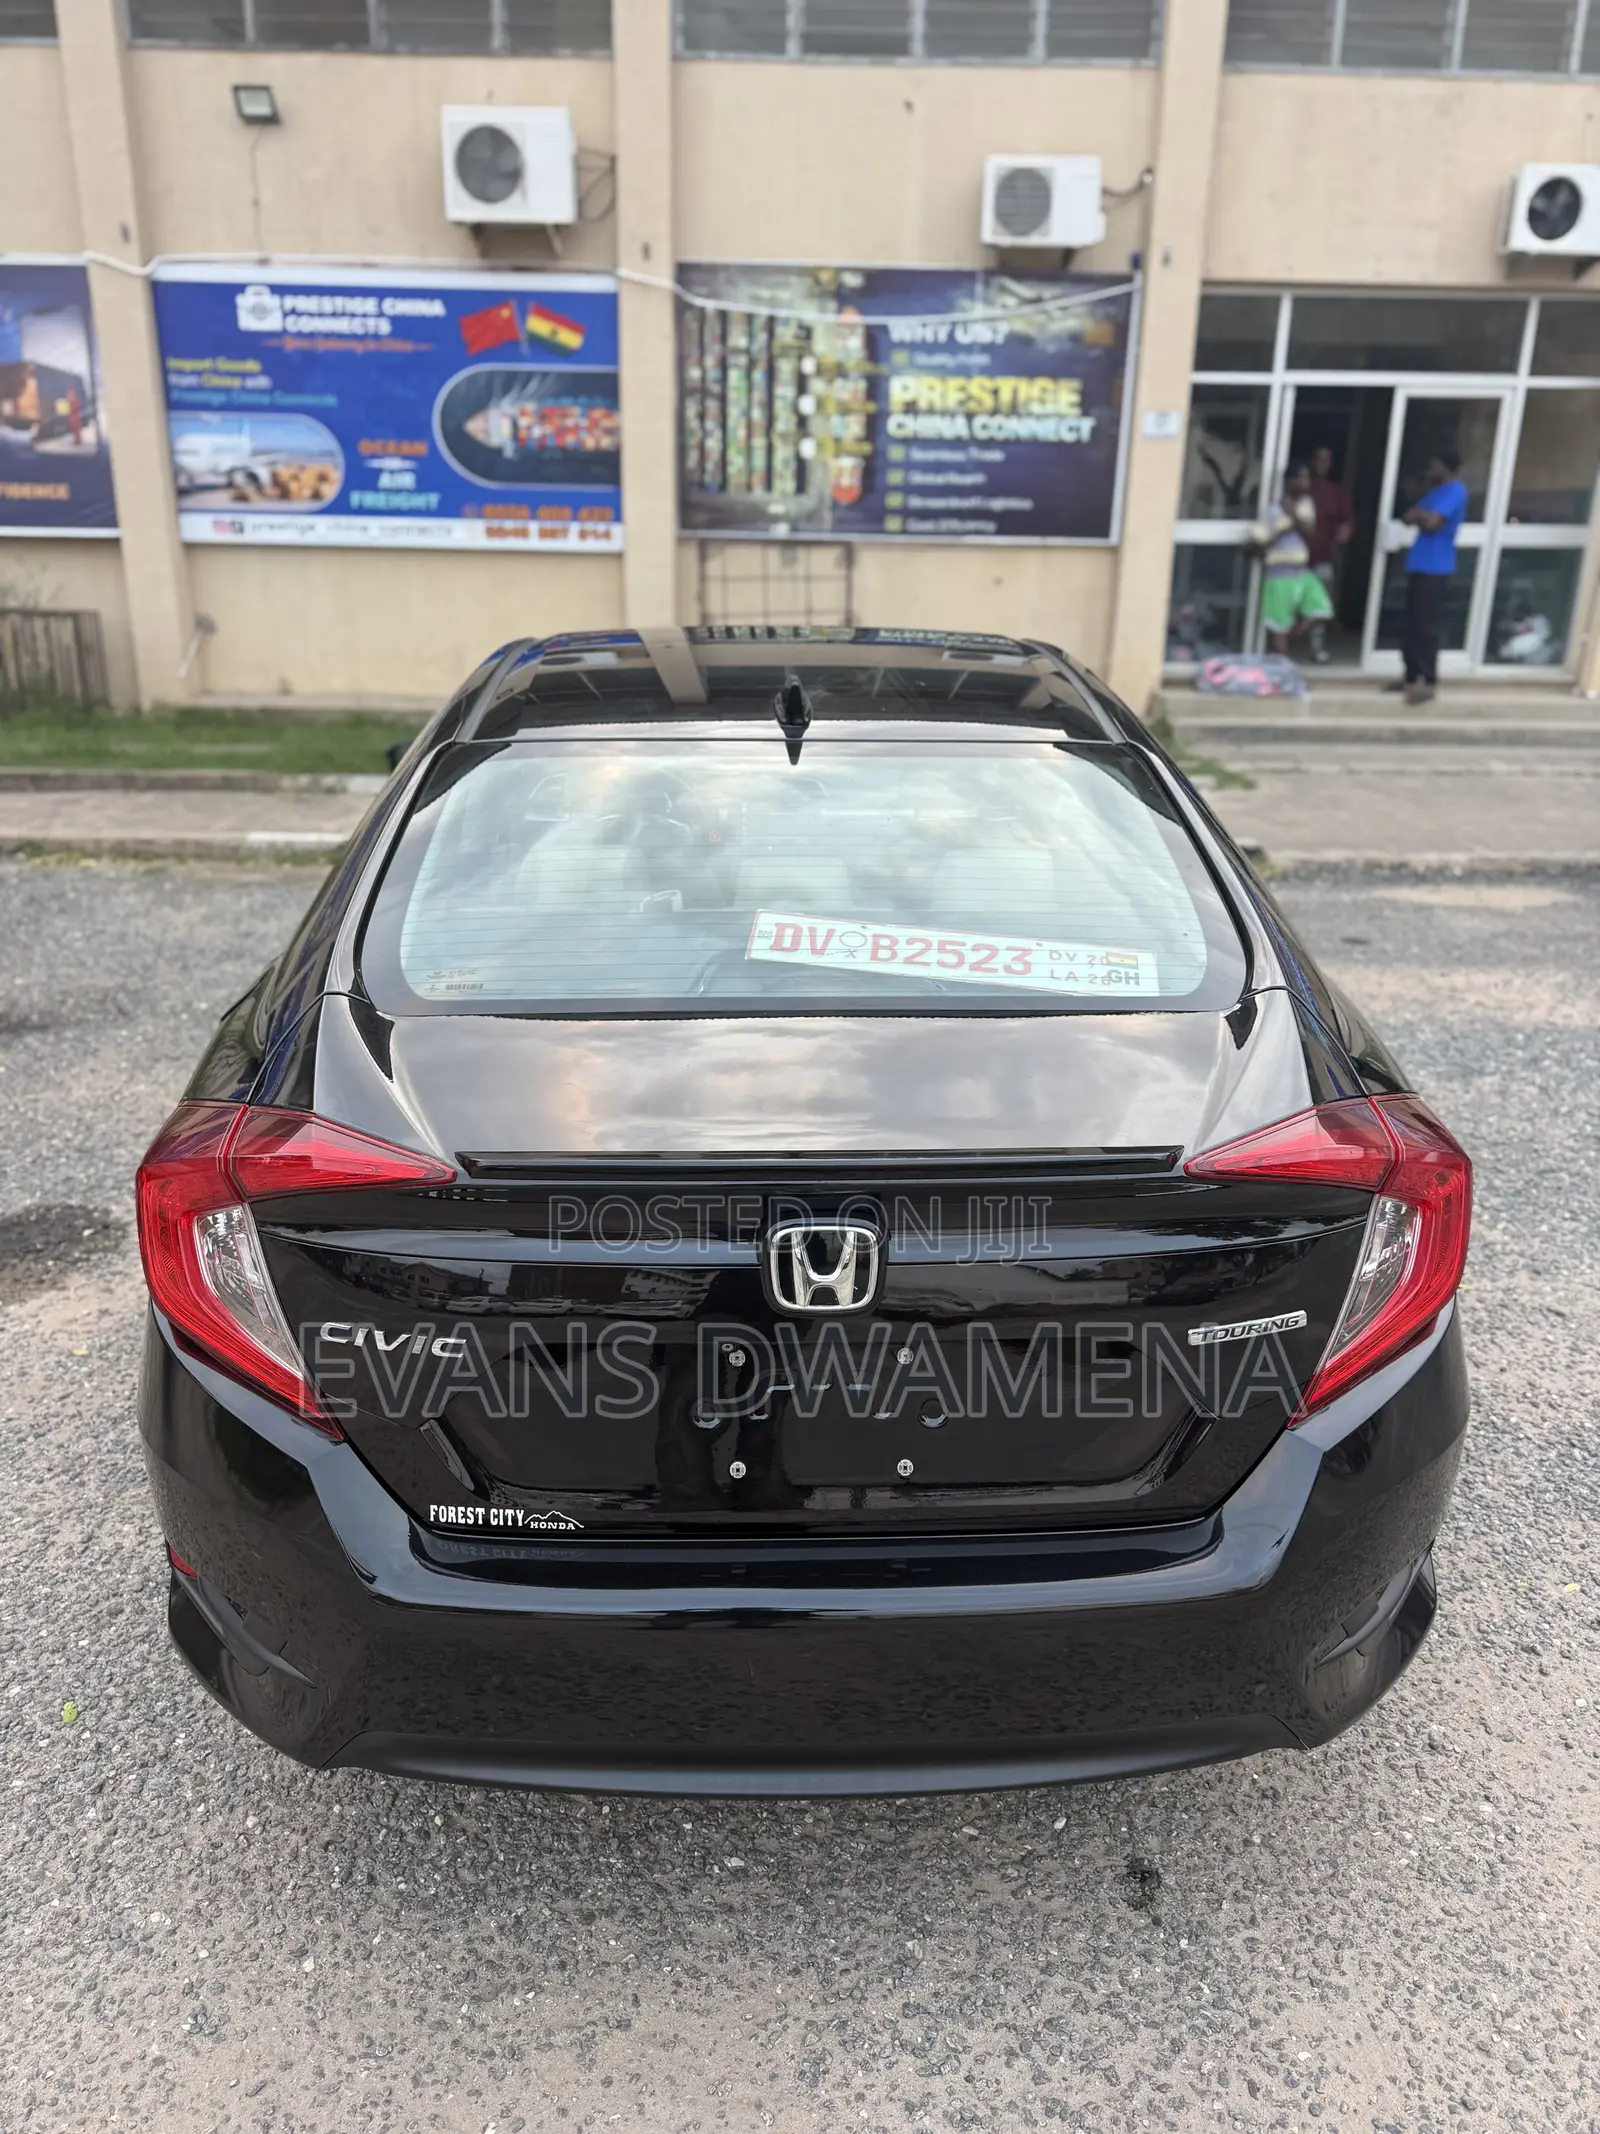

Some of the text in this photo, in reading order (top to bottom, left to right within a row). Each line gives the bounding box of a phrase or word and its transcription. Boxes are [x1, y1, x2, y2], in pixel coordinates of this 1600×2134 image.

[282, 294, 446, 317] PRESTIGE CHINA
[284, 314, 392, 335] CONNECTS
[889, 376, 1083, 416] PRESTIGE
[887, 413, 1097, 443] CHINA CONNECT
[357, 438, 429, 457] OCEAN
[378, 470, 416, 491] AIR
[349, 490, 442, 511] FREIGHT
[769, 922, 1033, 976] DV B2523
[1049, 950, 1078, 963] DV
[1050, 969, 1079, 982] LA
[1107, 969, 1140, 987] GH
[1192, 1314, 1301, 1343] TOURING
[319, 1322, 468, 1359] CIVIC
[429, 1504, 525, 1527] FOREST CITY
[530, 1521, 576, 1530] HONDA
